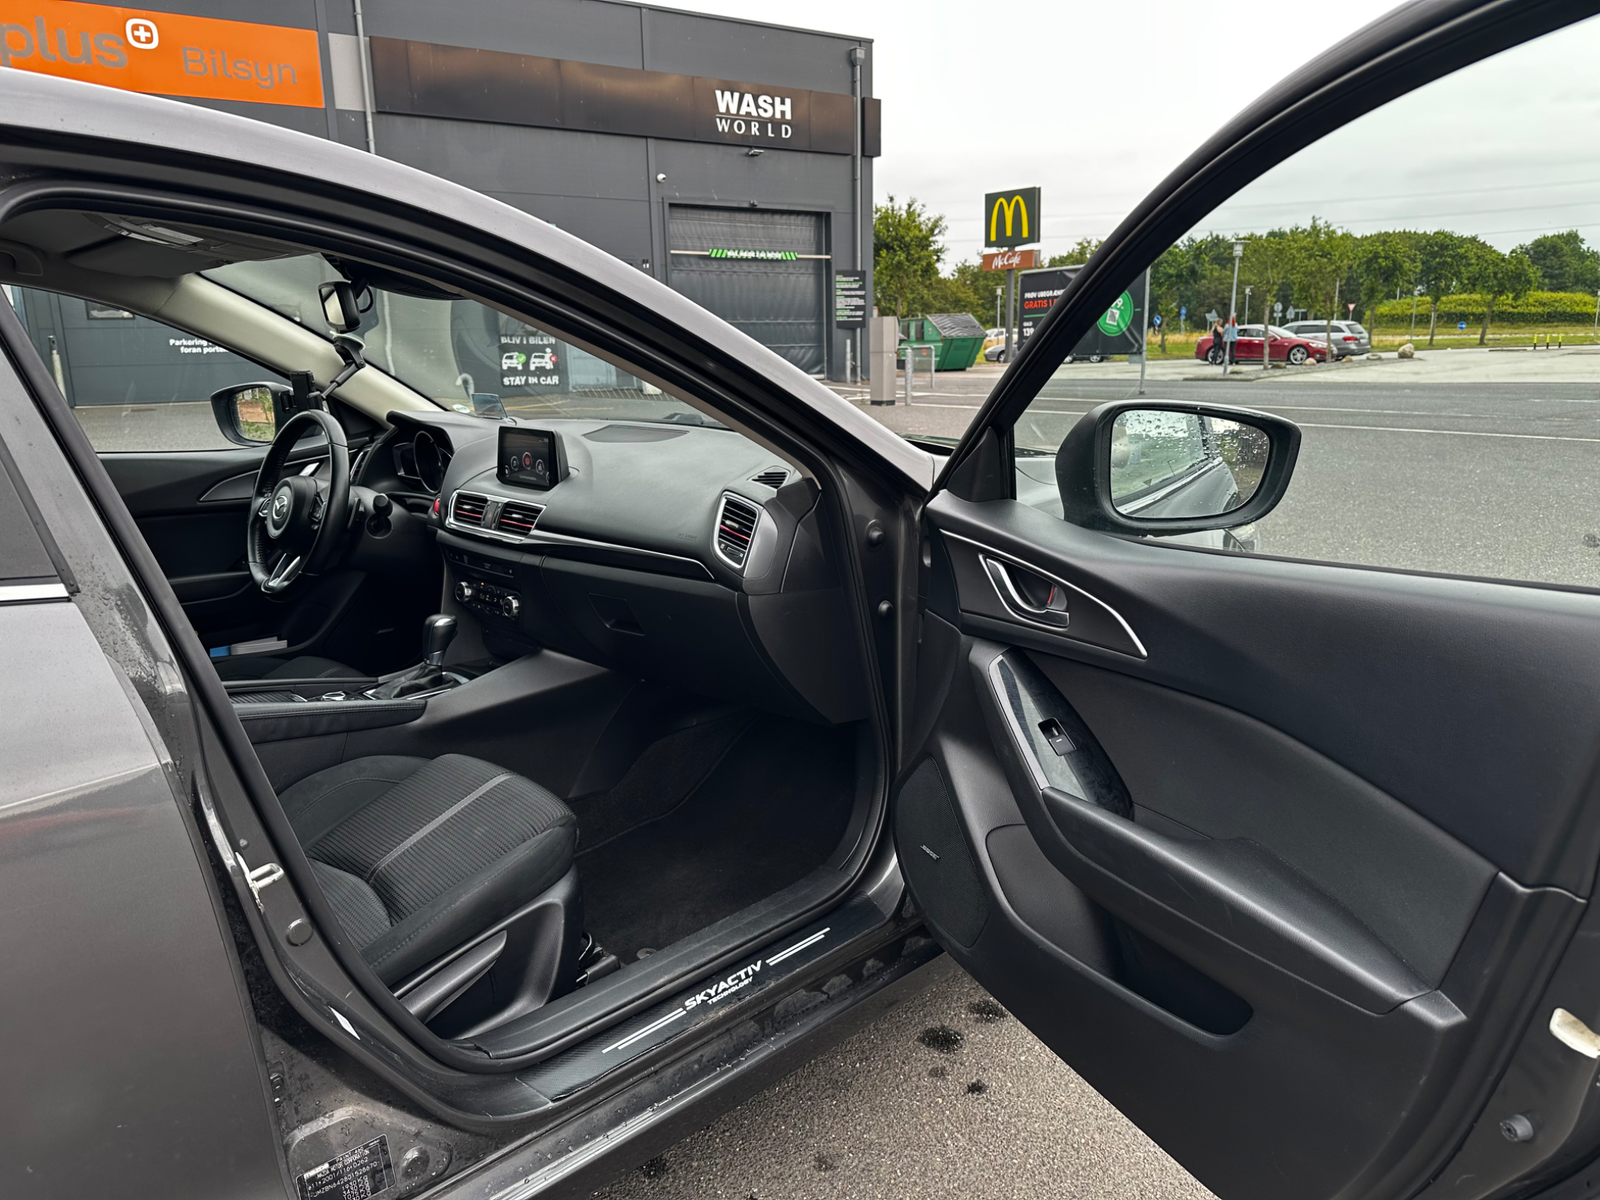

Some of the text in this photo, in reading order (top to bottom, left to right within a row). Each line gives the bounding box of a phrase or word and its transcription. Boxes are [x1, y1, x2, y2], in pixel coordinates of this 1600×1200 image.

[0, 15, 298, 90] plus Bilsyn
[715, 89, 792, 120] WASH
[716, 117, 792, 139] WORLD
[1024, 299, 1048, 309] GRATIS
[169, 338, 208, 347] Parkering
[500, 336, 521, 344] BLIV
[529, 336, 556, 345] BILEN
[180, 345, 202, 353] foran
[503, 375, 560, 386] STAY IN CAR
[684, 959, 762, 1011] SKYACTIV
[707, 976, 753, 1005] TECHNOLOGY
